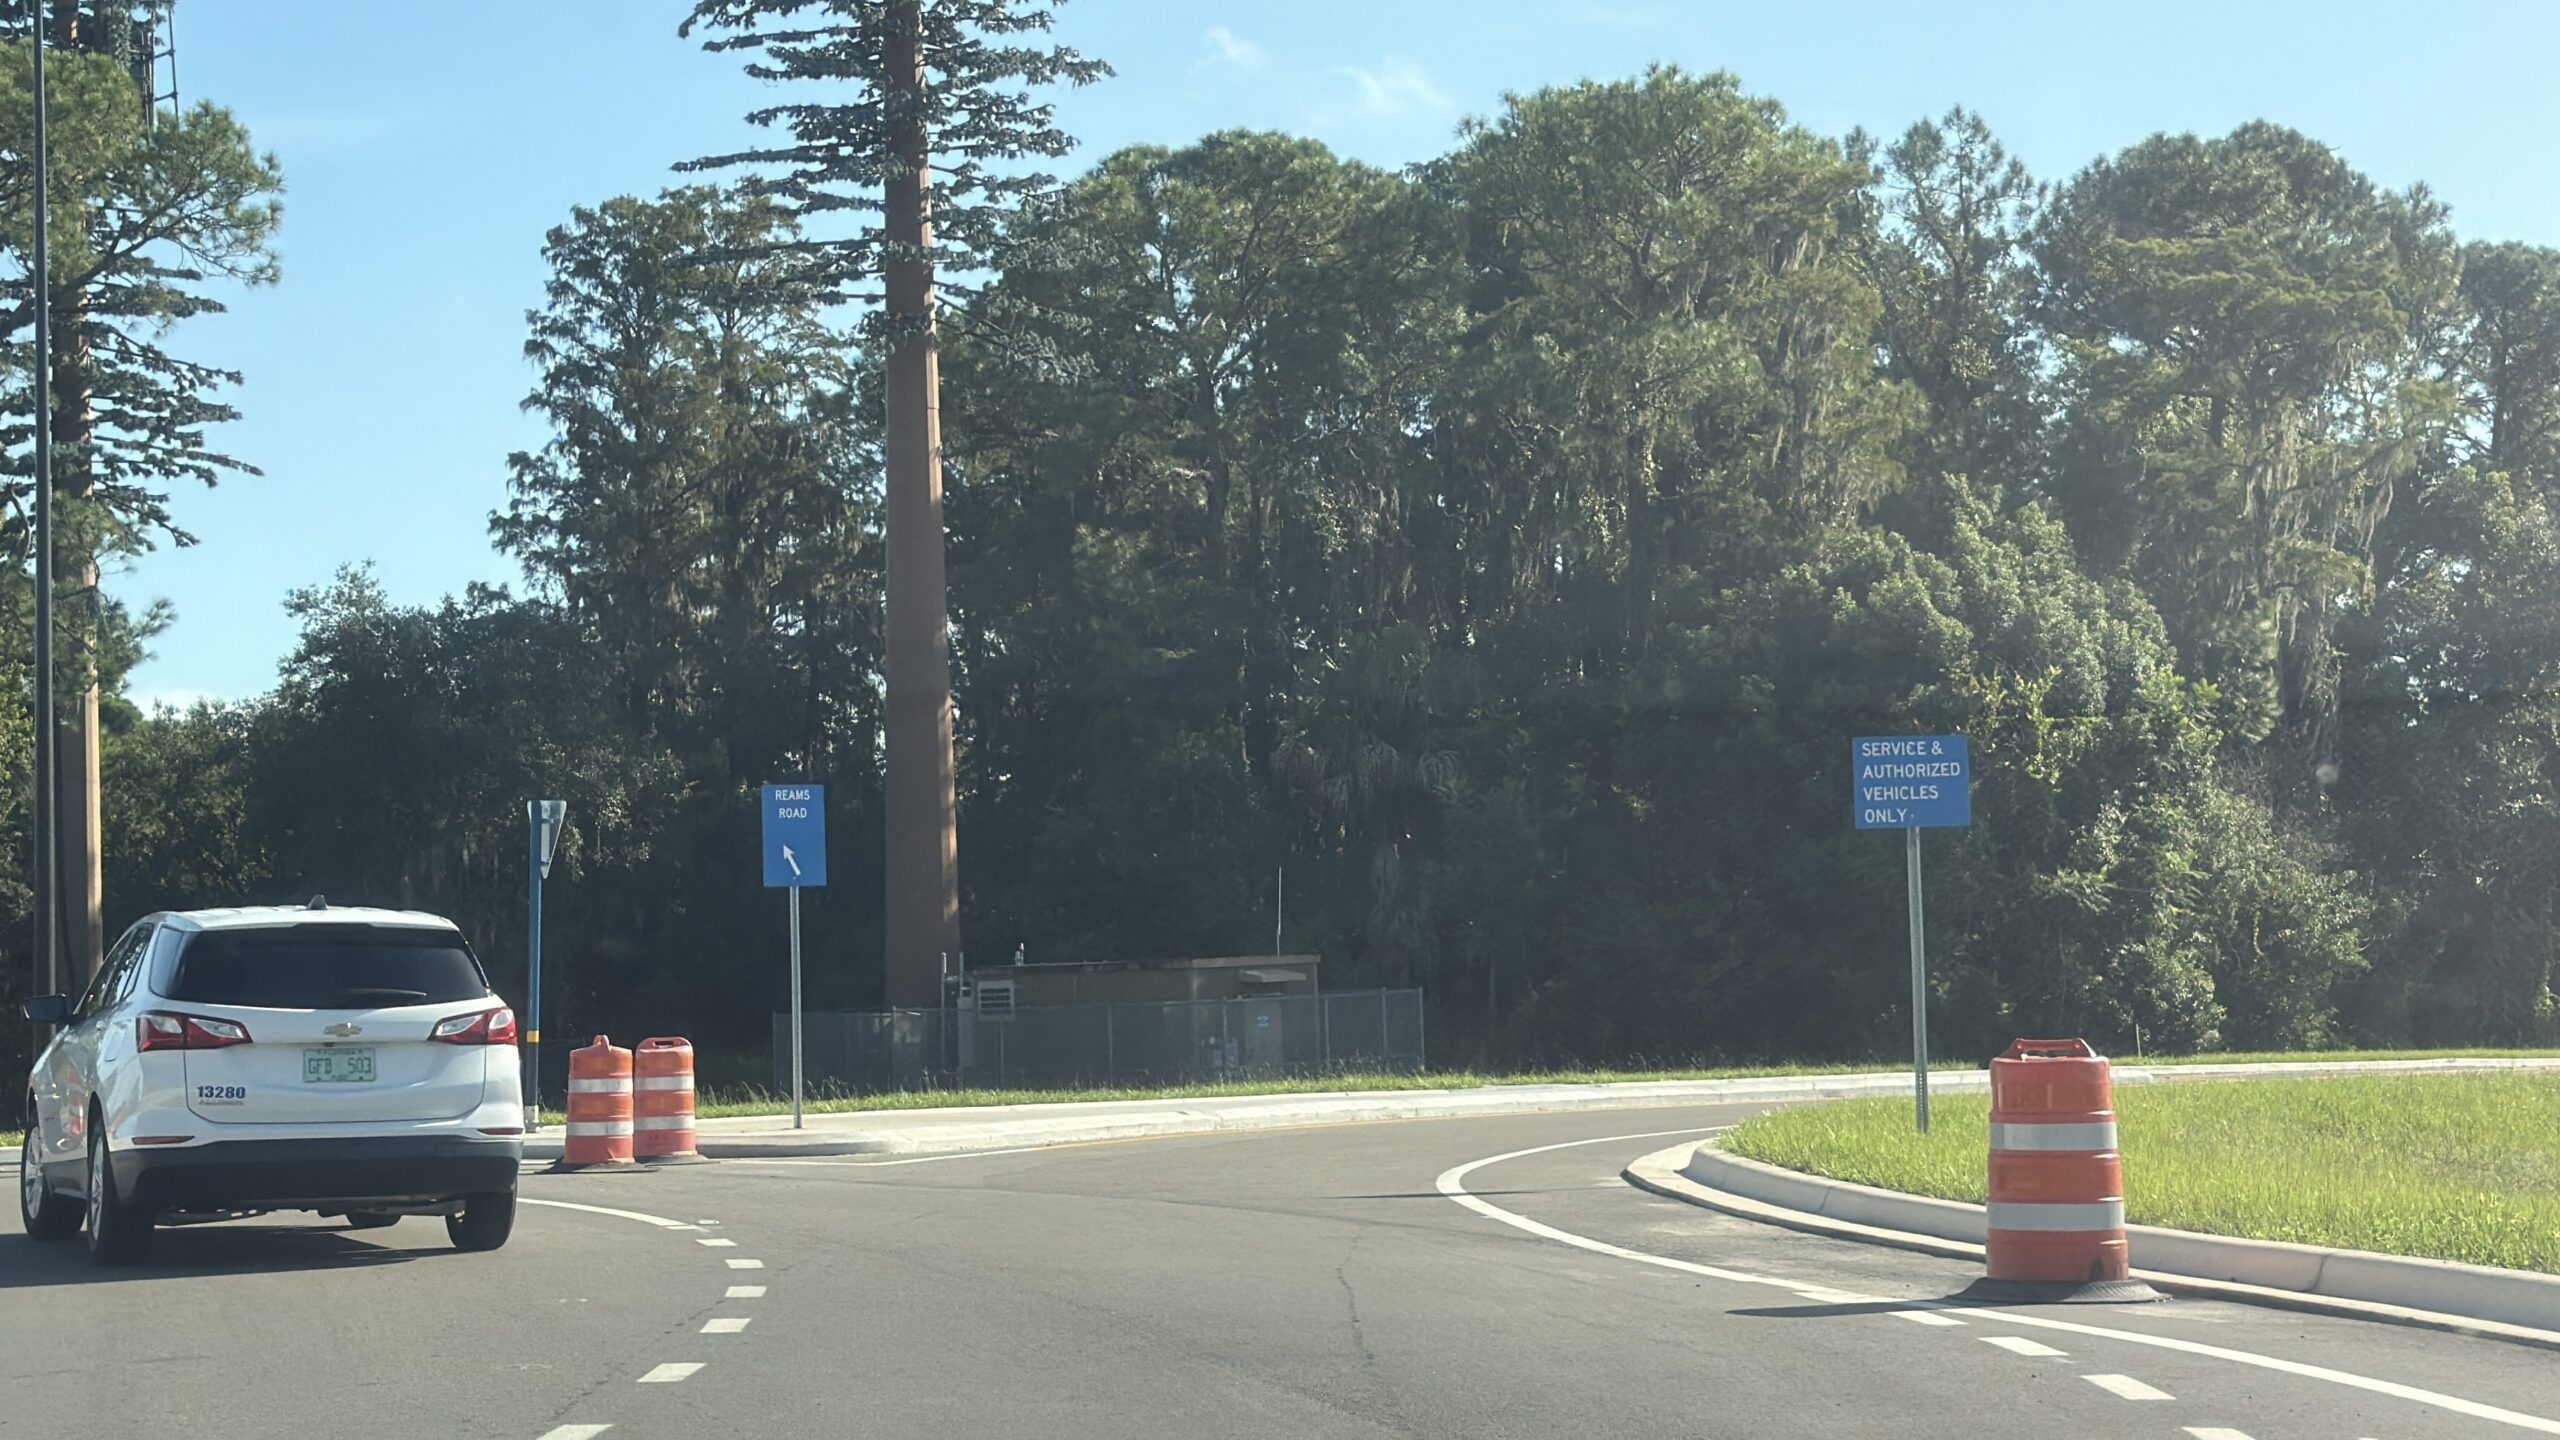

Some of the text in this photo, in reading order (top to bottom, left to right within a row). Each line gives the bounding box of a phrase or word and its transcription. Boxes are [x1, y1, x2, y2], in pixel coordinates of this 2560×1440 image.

[1862, 740, 1943, 757] SERVICE &
[1862, 762, 1961, 779] AUTHORIZED
[775, 789, 810, 801] REAMS
[1863, 785, 1939, 801] VEHICLES
[779, 807, 807, 819] ROAD
[1864, 808, 1907, 823] ONLY
[347, 1057, 372, 1074] 503
[197, 1085, 246, 1099] 13280
